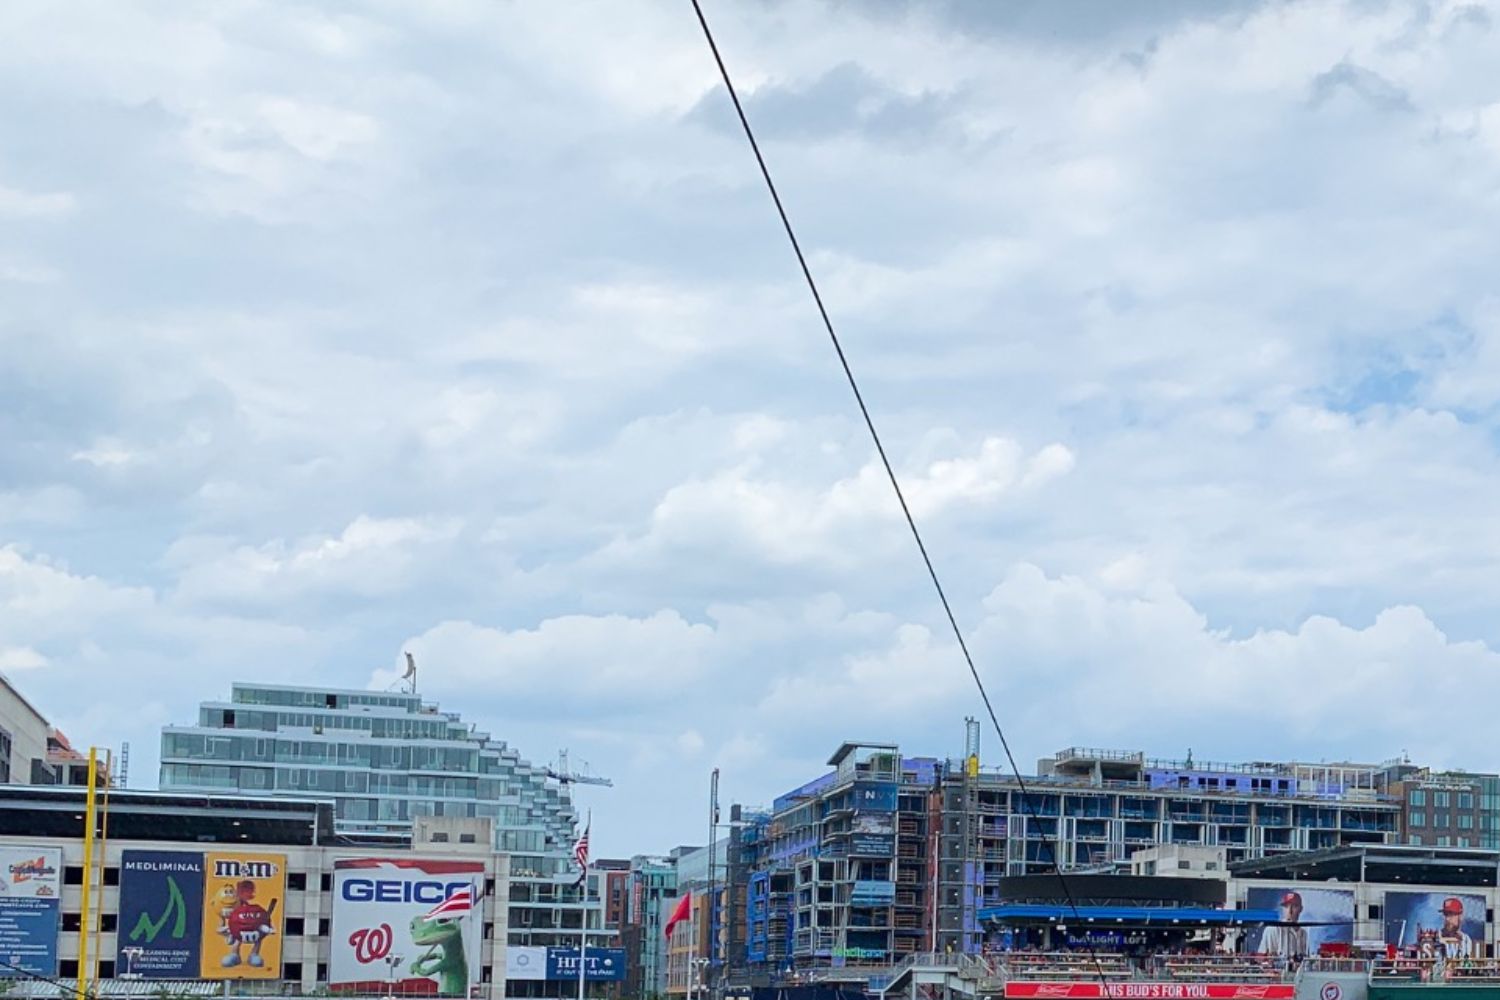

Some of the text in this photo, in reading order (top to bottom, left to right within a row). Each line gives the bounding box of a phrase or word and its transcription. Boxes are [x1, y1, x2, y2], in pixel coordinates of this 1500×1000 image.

[125, 862, 201, 872] MEDLIMINAL
[1092, 936, 1120, 944] LIGHT
[1123, 936, 1147, 944] LOFT
[557, 957, 600, 968] HITT
[1100, 985, 1210, 997] THIS BUD'S FOR YOU.
